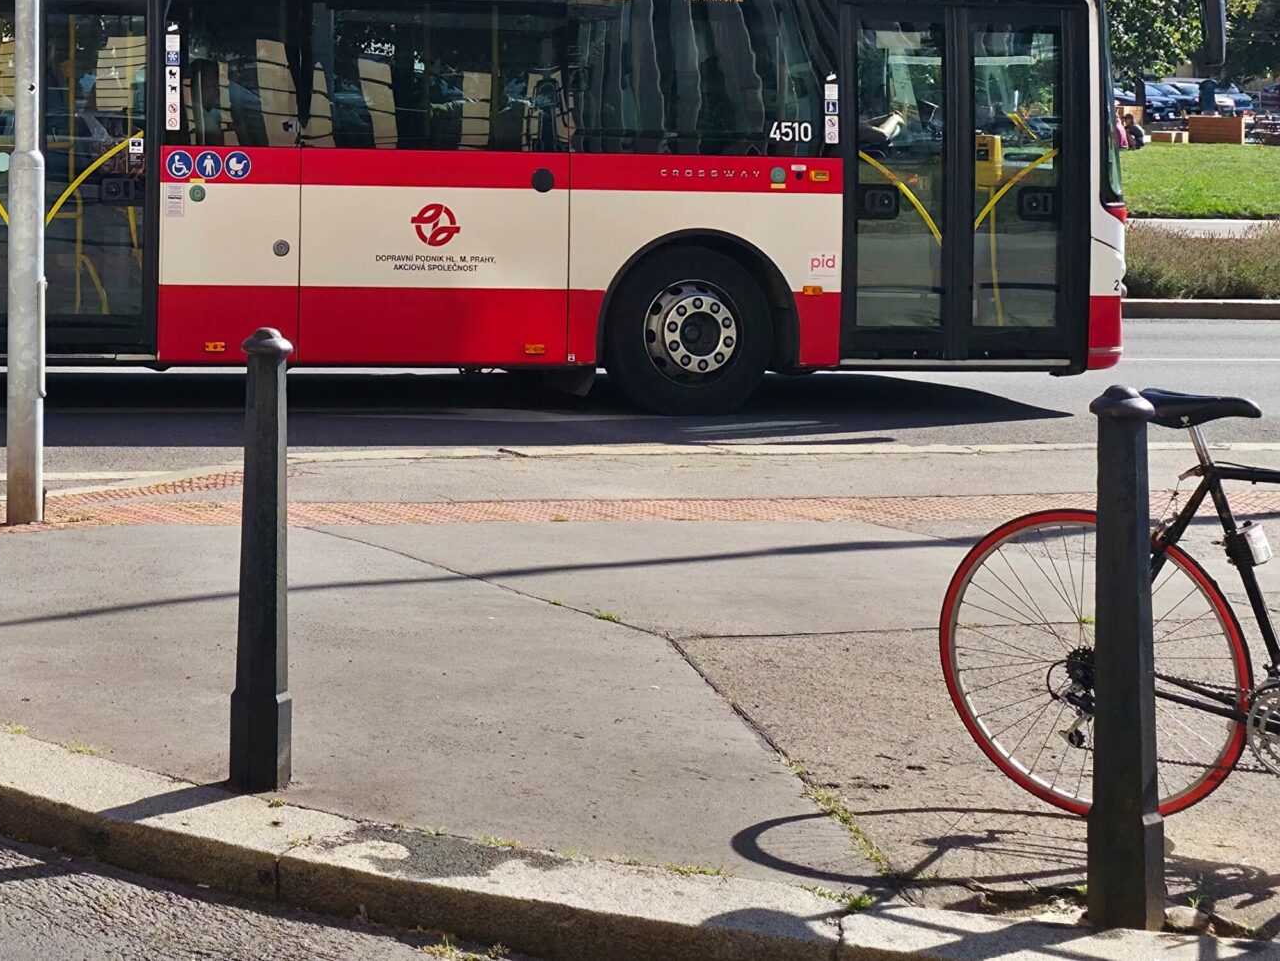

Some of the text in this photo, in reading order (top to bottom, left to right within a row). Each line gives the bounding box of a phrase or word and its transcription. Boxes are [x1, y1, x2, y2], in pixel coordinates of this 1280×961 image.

[770, 121, 812, 142] 4510
[660, 169, 761, 178] CROSSWAY
[375, 253, 497, 265] DOPRAVNÍ PODNIK HL. M. PRAHY,
[810, 253, 836, 272] pid
[393, 261, 478, 272] AKCIOVÁ SPOLEČNOST
[1113, 279, 1120, 292] 2
